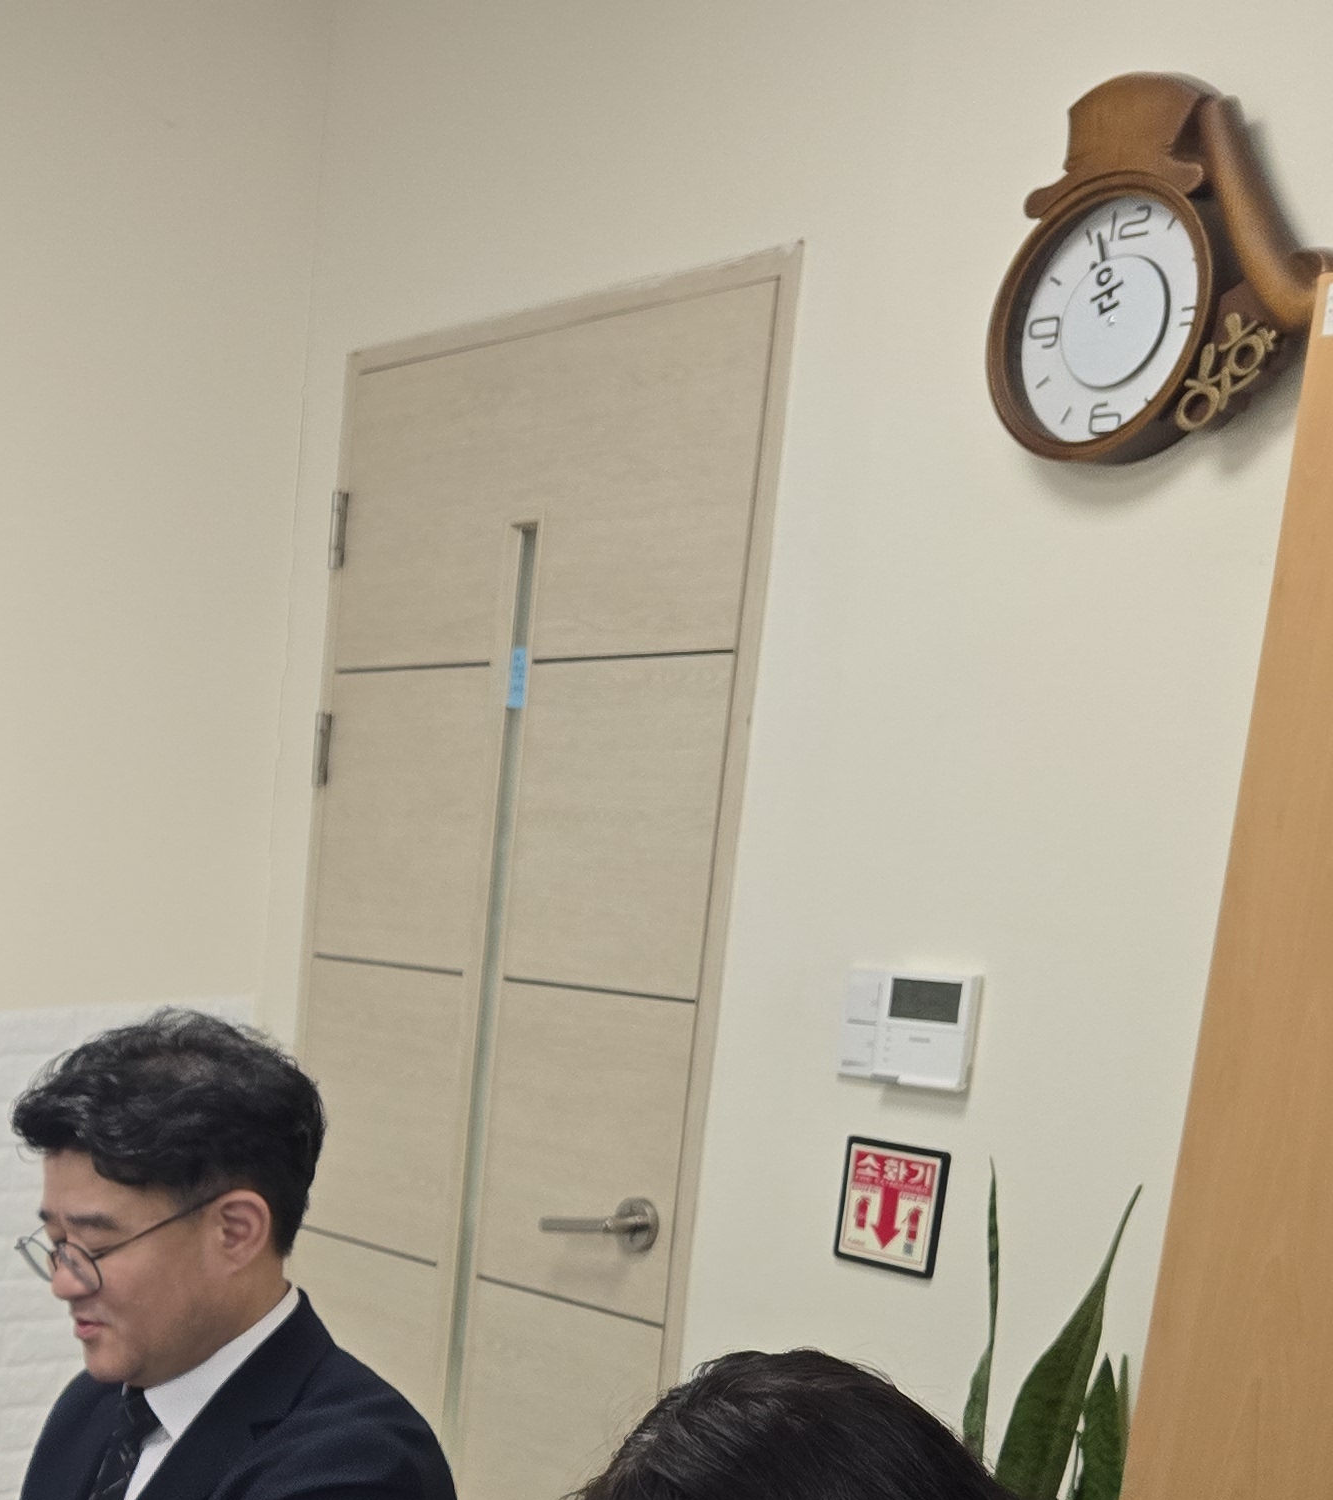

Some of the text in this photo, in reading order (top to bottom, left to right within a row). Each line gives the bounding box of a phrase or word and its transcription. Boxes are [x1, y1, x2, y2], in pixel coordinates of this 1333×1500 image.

[1110, 205, 1151, 241] 12
[1029, 317, 1060, 348] 9
[1088, 402, 1121, 435] 6
[856, 1153, 933, 1188] 소화기
